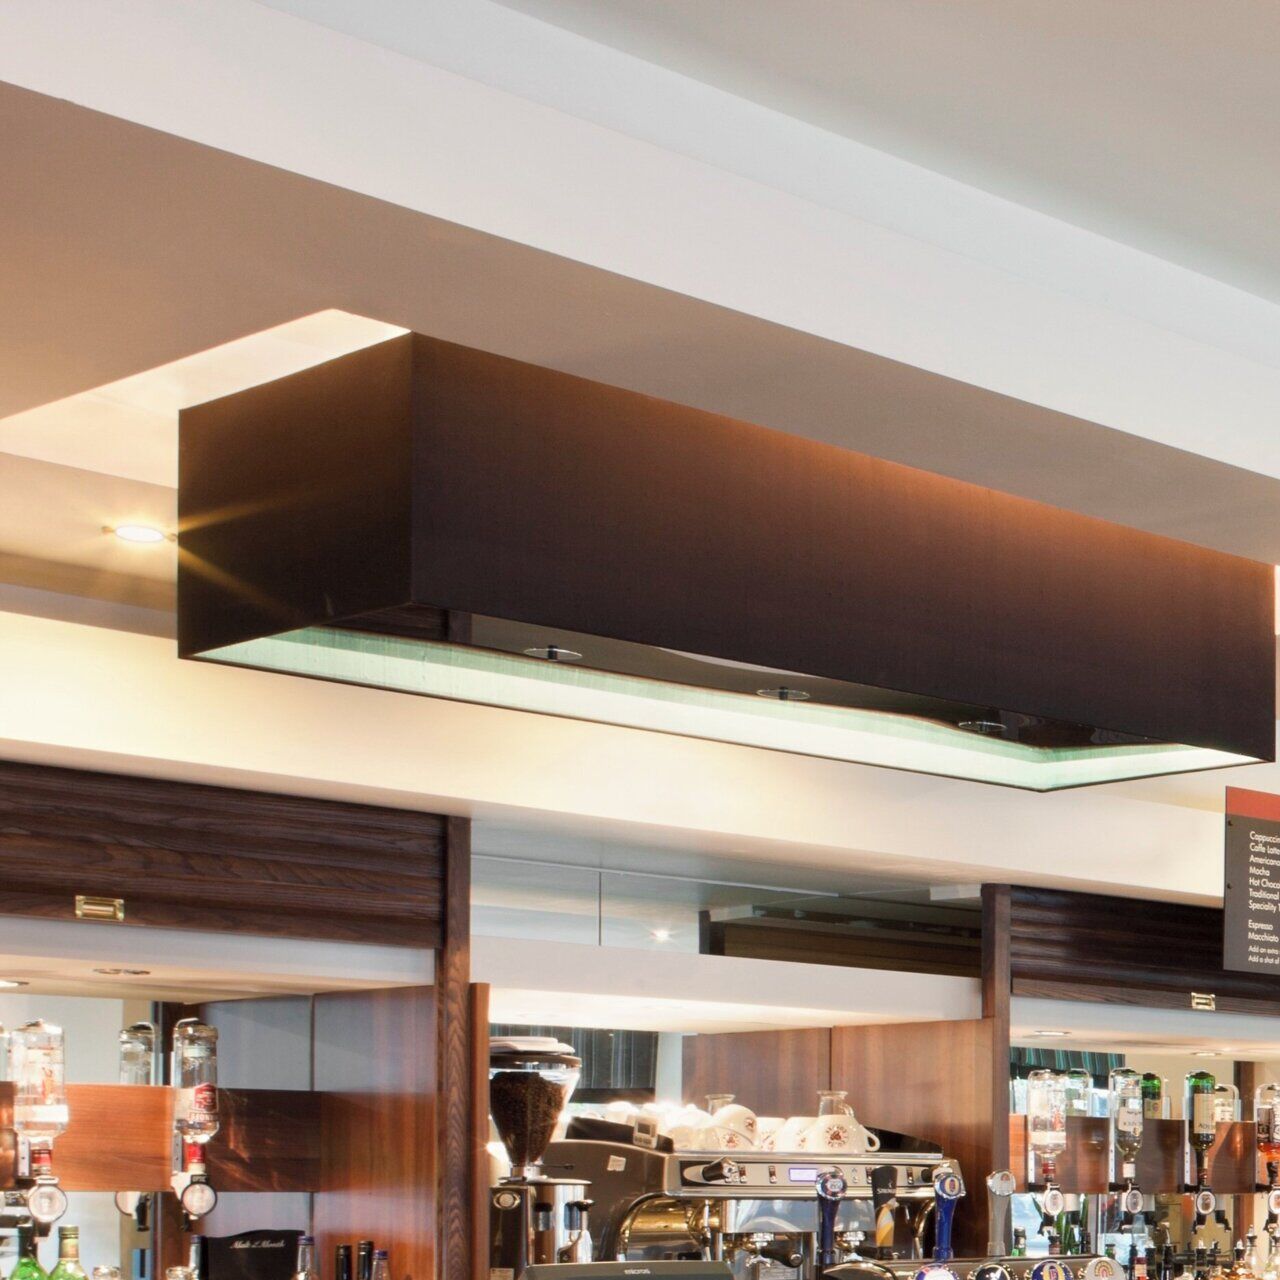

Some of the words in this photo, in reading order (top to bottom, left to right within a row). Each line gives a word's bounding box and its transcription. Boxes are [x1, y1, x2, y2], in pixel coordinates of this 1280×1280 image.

[1267, 846, 1280, 855] Latte
[1249, 855, 1280, 866] Americano
[1249, 866, 1270, 876] Mocha
[1249, 877, 1260, 886] Hot
[1249, 888, 1279, 900] Traditional
[1249, 900, 1276, 913] Speciality
[1248, 920, 1273, 930] Espresso
[1248, 932, 1279, 942] Macchiato
